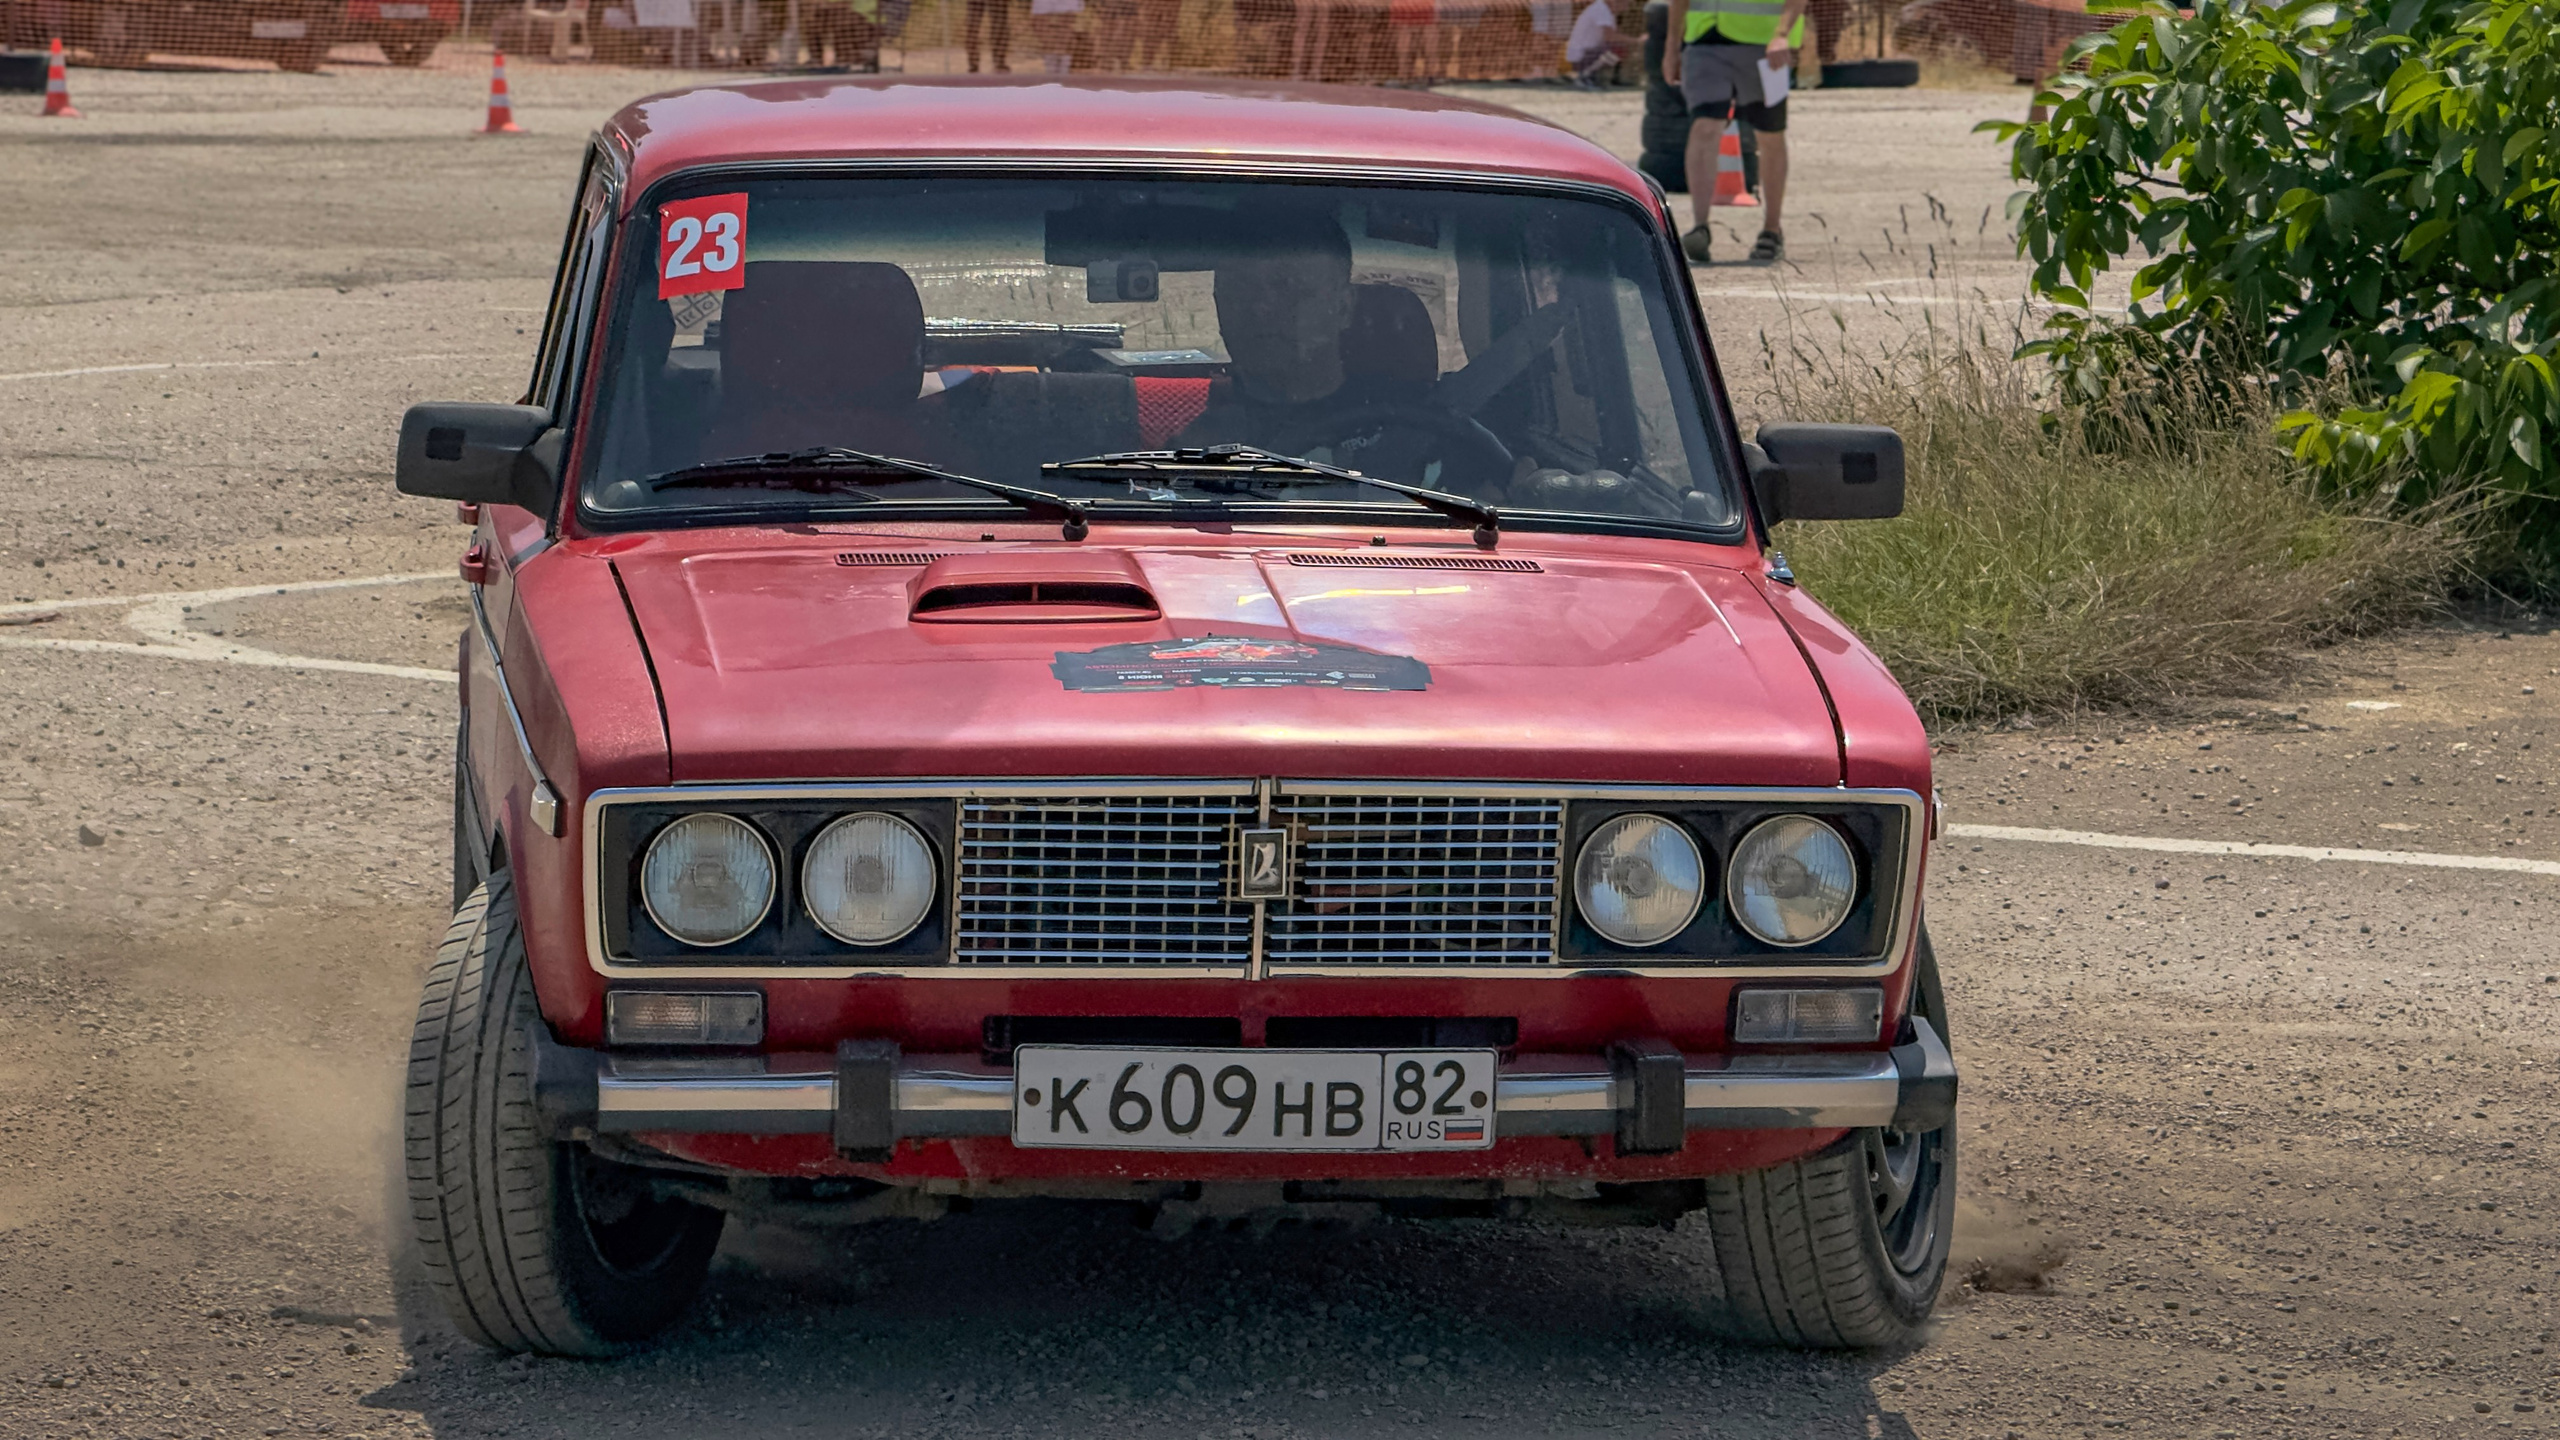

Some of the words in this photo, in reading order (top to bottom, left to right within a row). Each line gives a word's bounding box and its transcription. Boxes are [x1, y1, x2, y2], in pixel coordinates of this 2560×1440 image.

[664, 212, 740, 280] 23
[1392, 1059, 1466, 1116] 82
[1387, 1121, 1441, 1140] RUS
